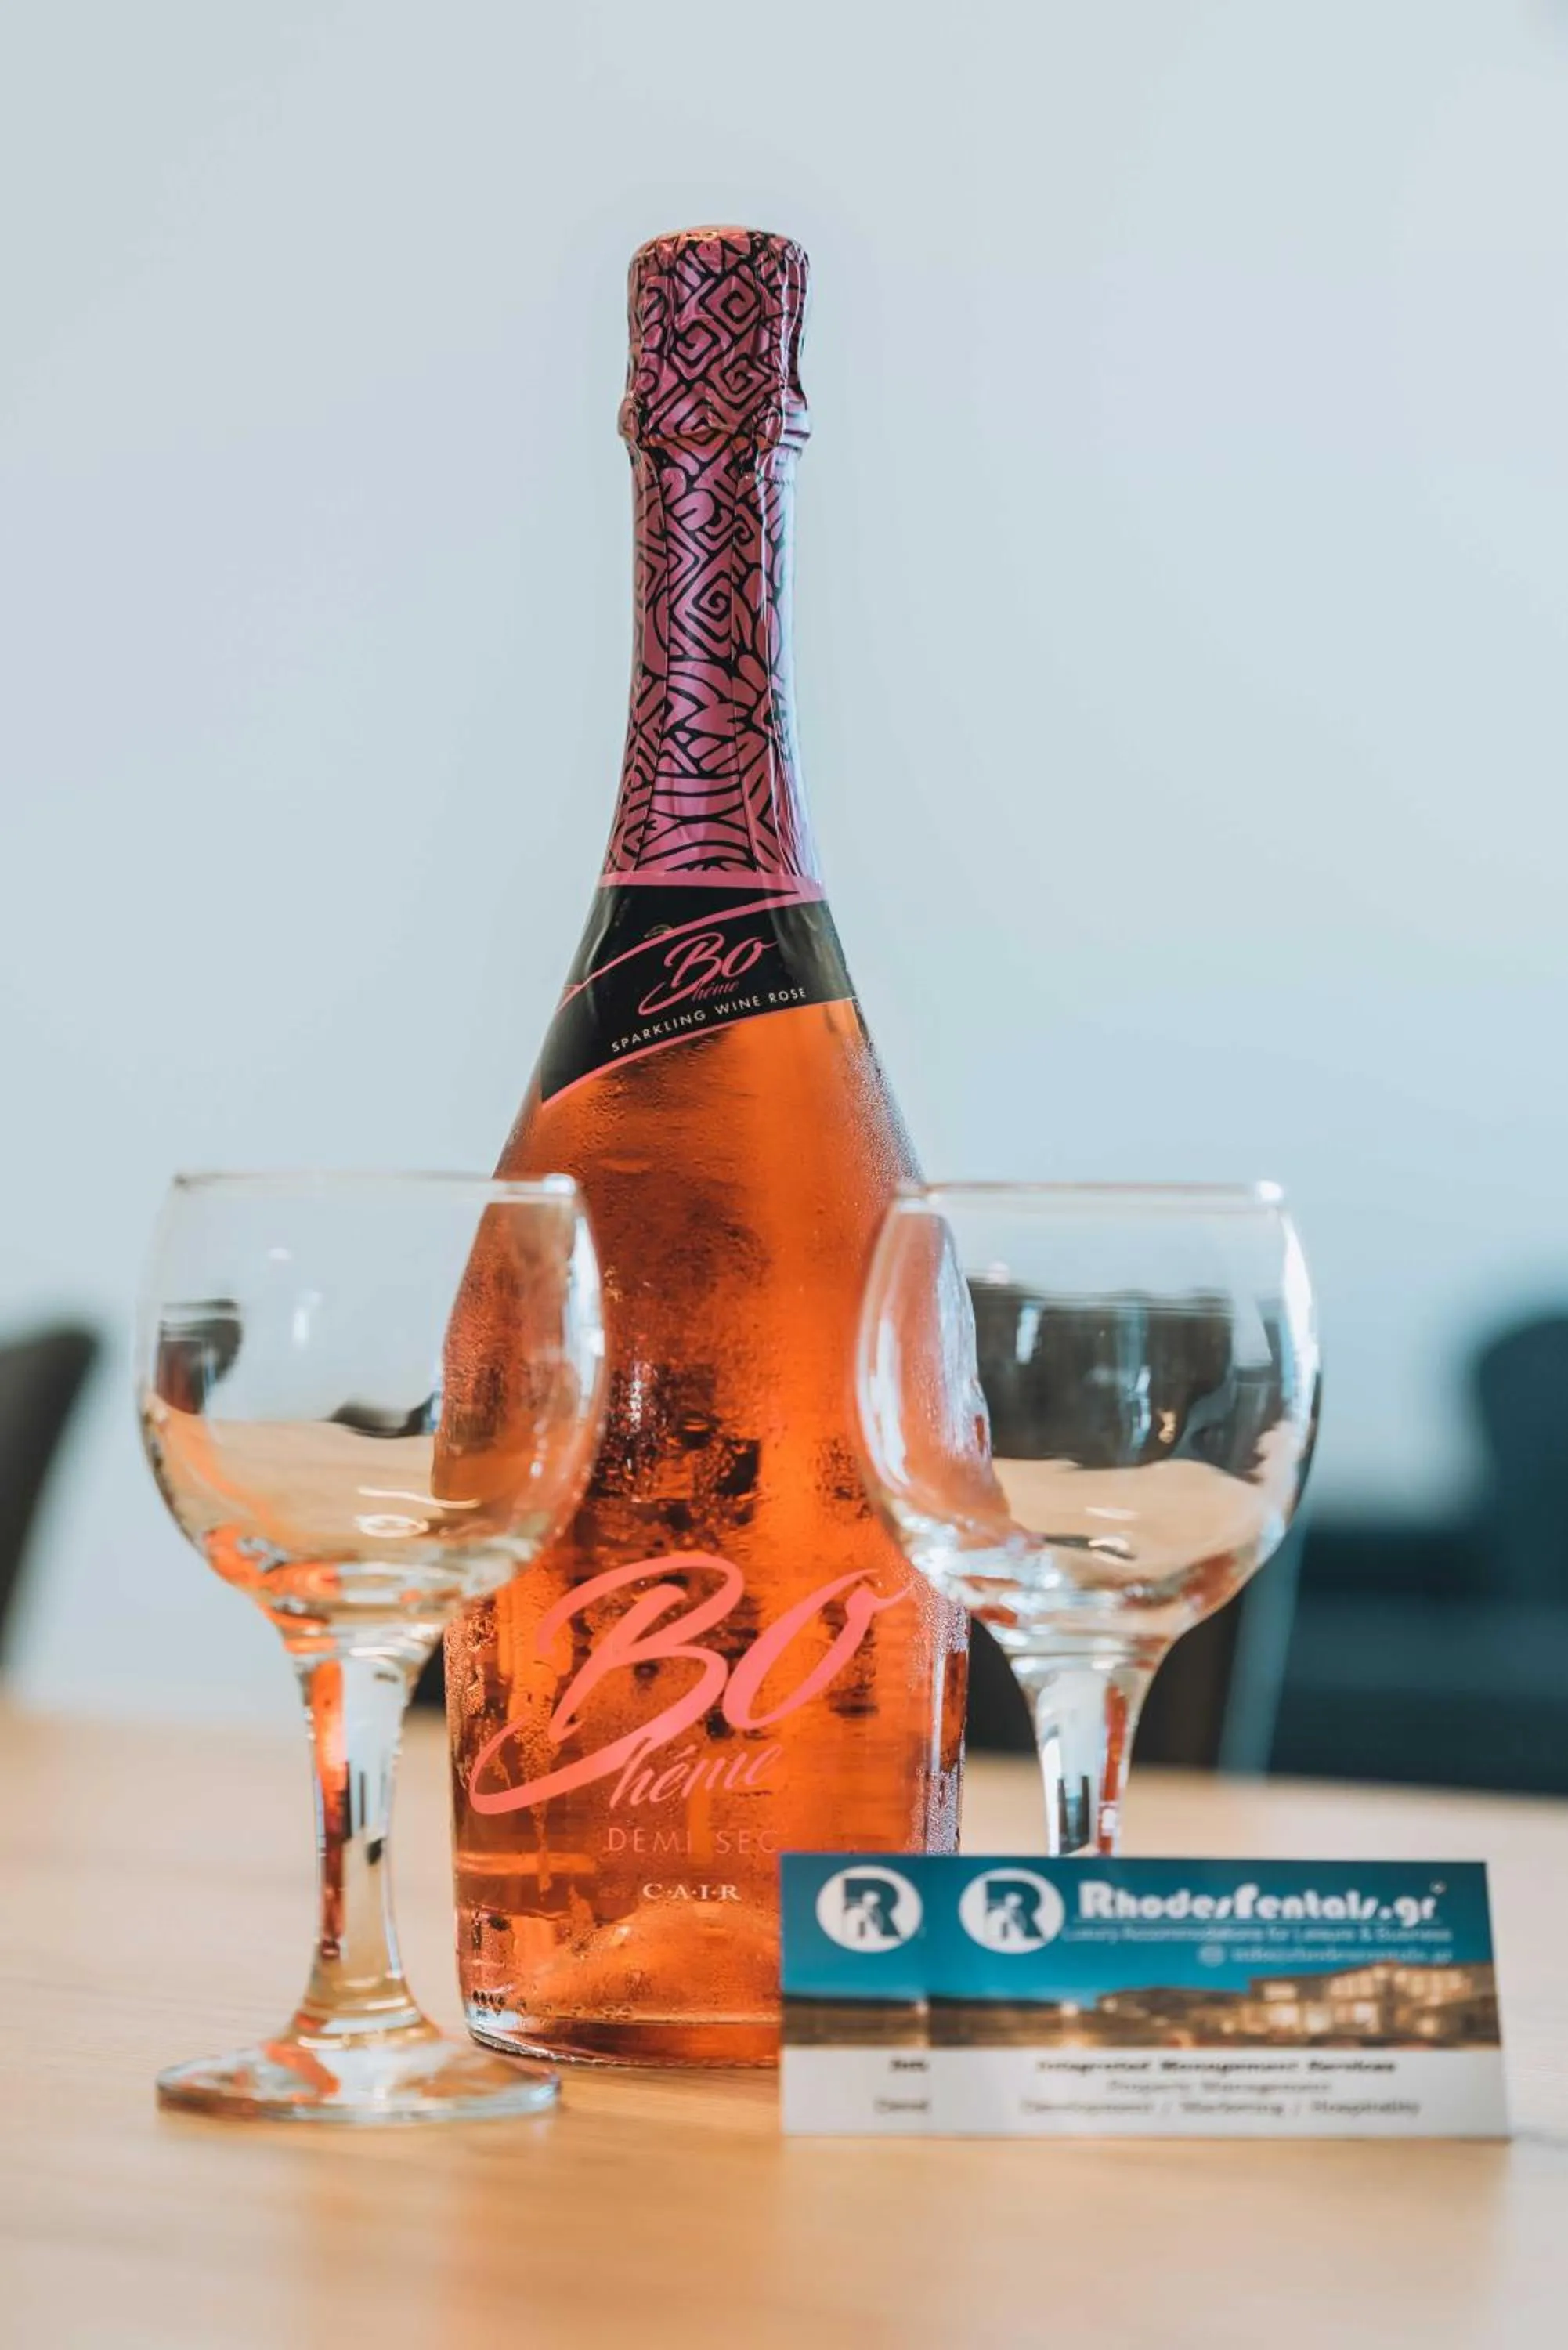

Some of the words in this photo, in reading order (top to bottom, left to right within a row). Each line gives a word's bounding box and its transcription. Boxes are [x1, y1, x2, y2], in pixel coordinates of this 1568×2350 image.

[610, 1010, 706, 1052] SPARKLING
[714, 996, 761, 1015] WINE
[768, 986, 807, 1003] ROSE
[607, 1827, 692, 1855] DEMI
[715, 1830, 779, 1854] SEC
